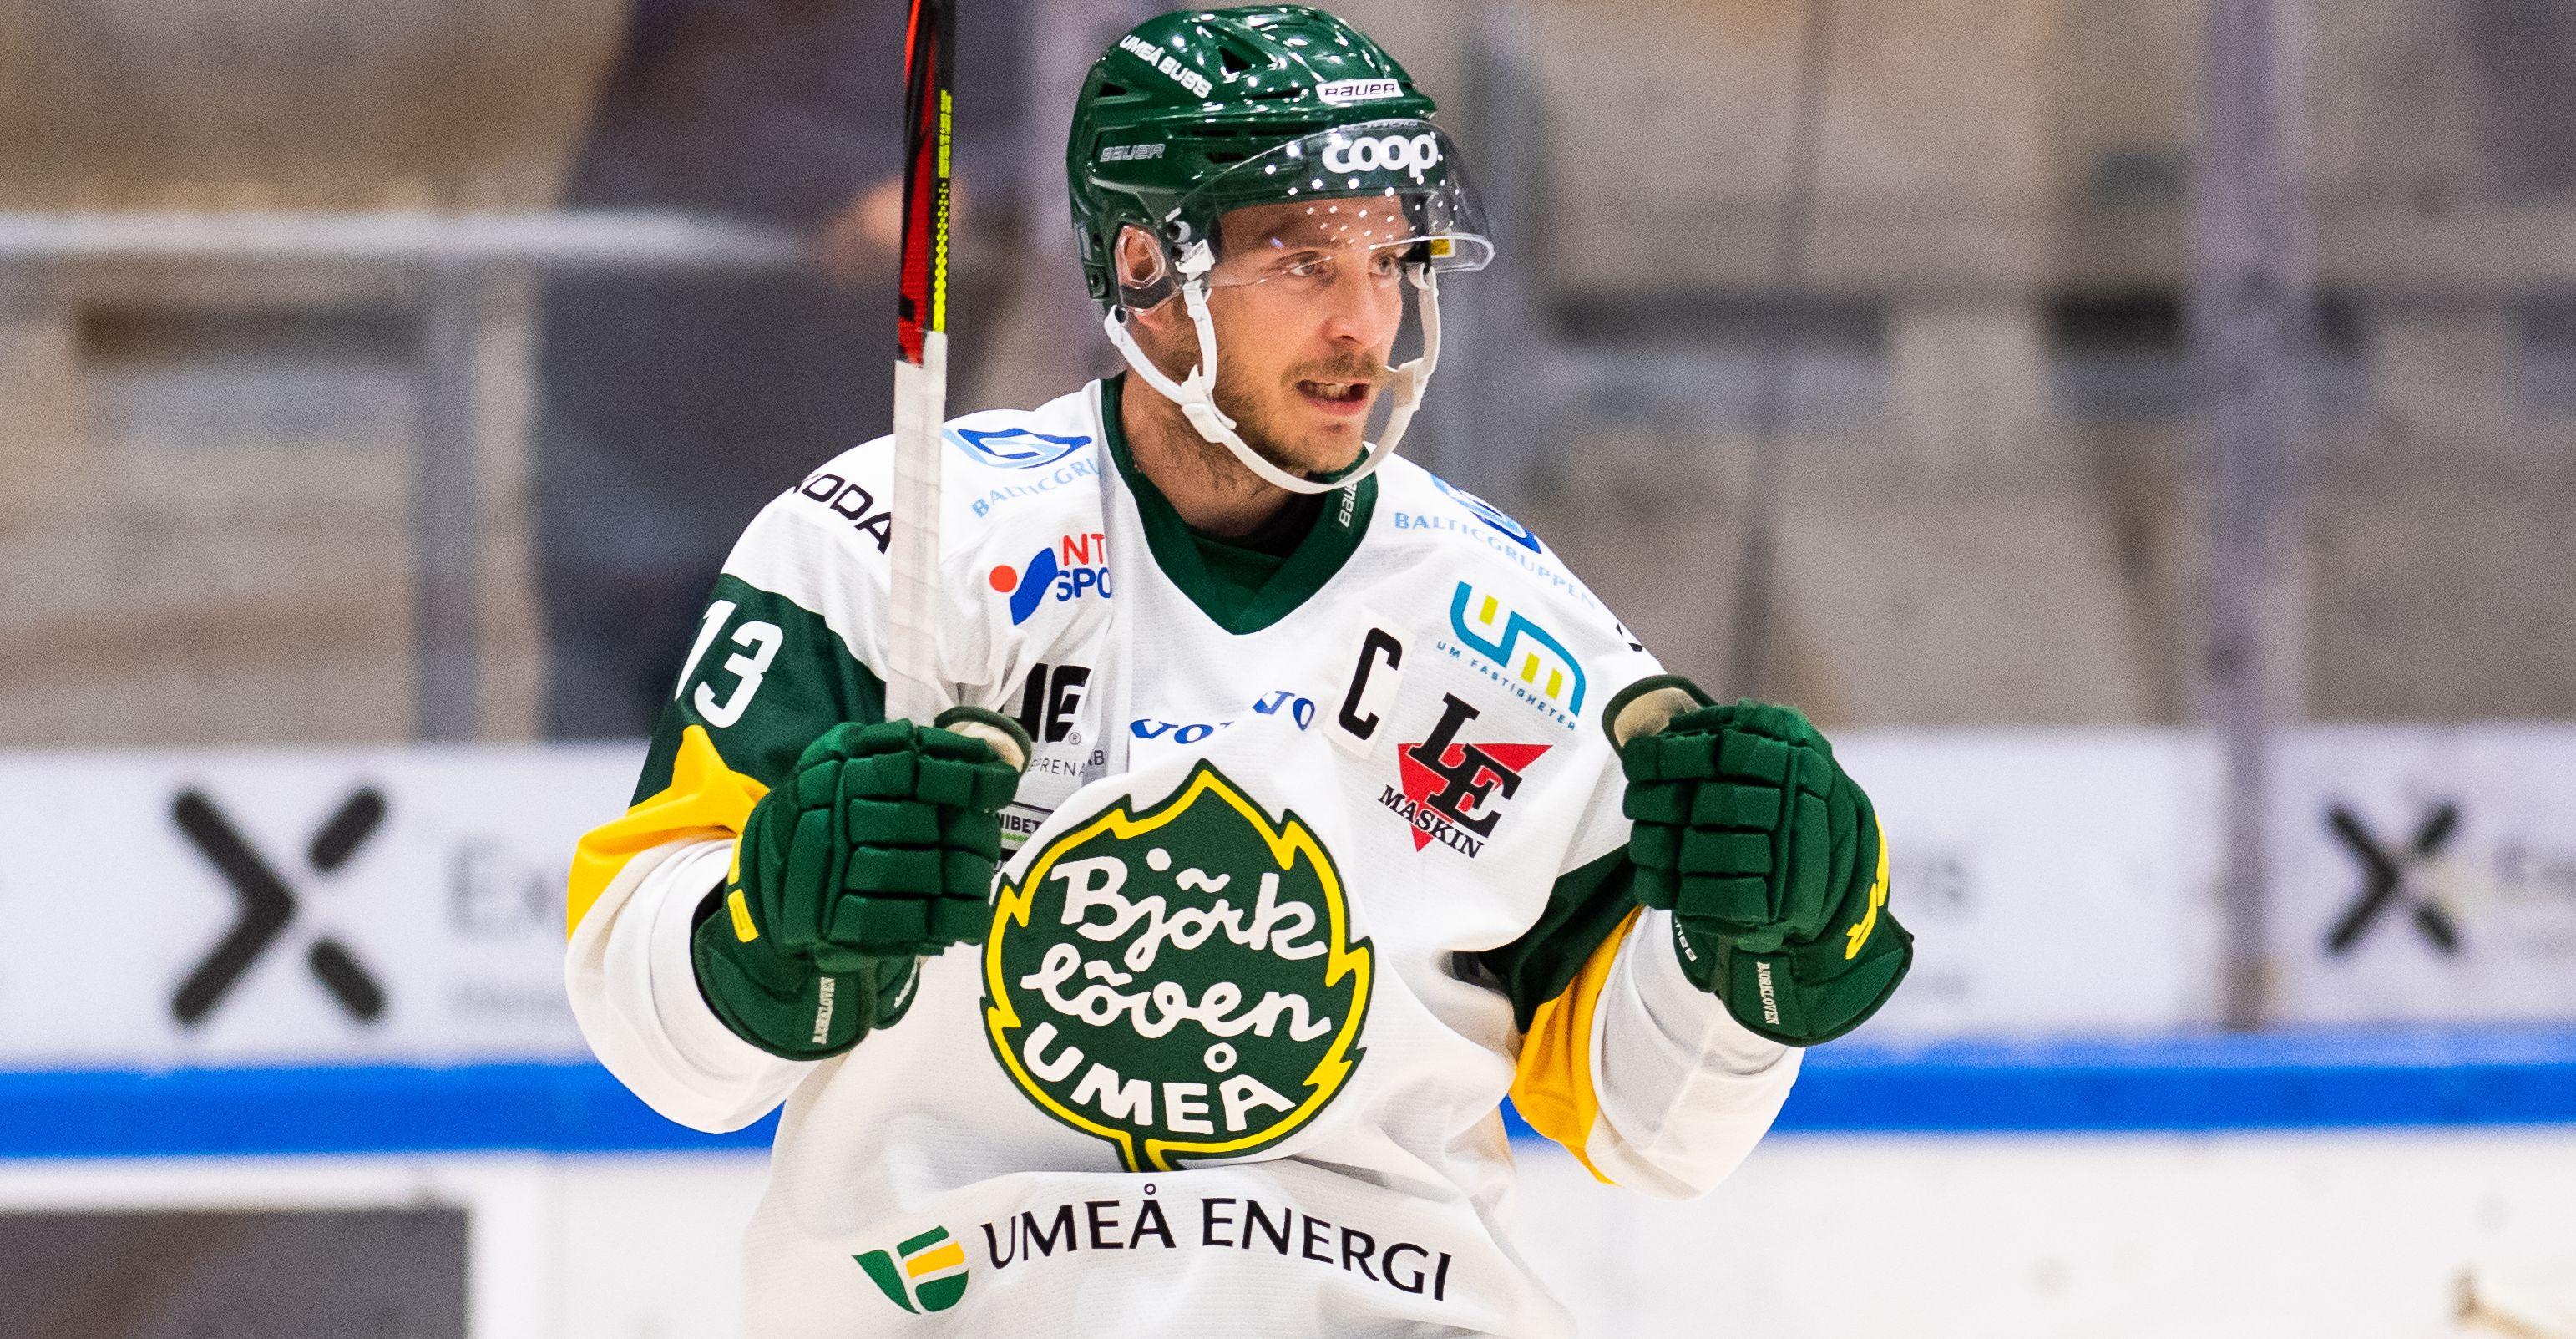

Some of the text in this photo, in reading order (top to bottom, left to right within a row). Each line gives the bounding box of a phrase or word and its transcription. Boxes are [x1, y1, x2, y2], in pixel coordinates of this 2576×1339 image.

[1157, 55, 1212, 99] BUSS
[1323, 134, 1439, 178] coop
[792, 474, 891, 555] ODA
[1338, 482, 1358, 528] BAU
[1055, 566, 1111, 602] SPO
[1394, 510, 1596, 609] BALTICGRUPPEN
[675, 599, 784, 728] 13
[1338, 626, 1403, 741] C
[1435, 640, 1576, 732] UM FASTIGHETER
[1408, 691, 1524, 839] LE
[1376, 784, 1485, 859] MASKIN
[1022, 1022, 1297, 1134] UMEÅ
[979, 1183, 1453, 1301] UMEÅ ENERGI
